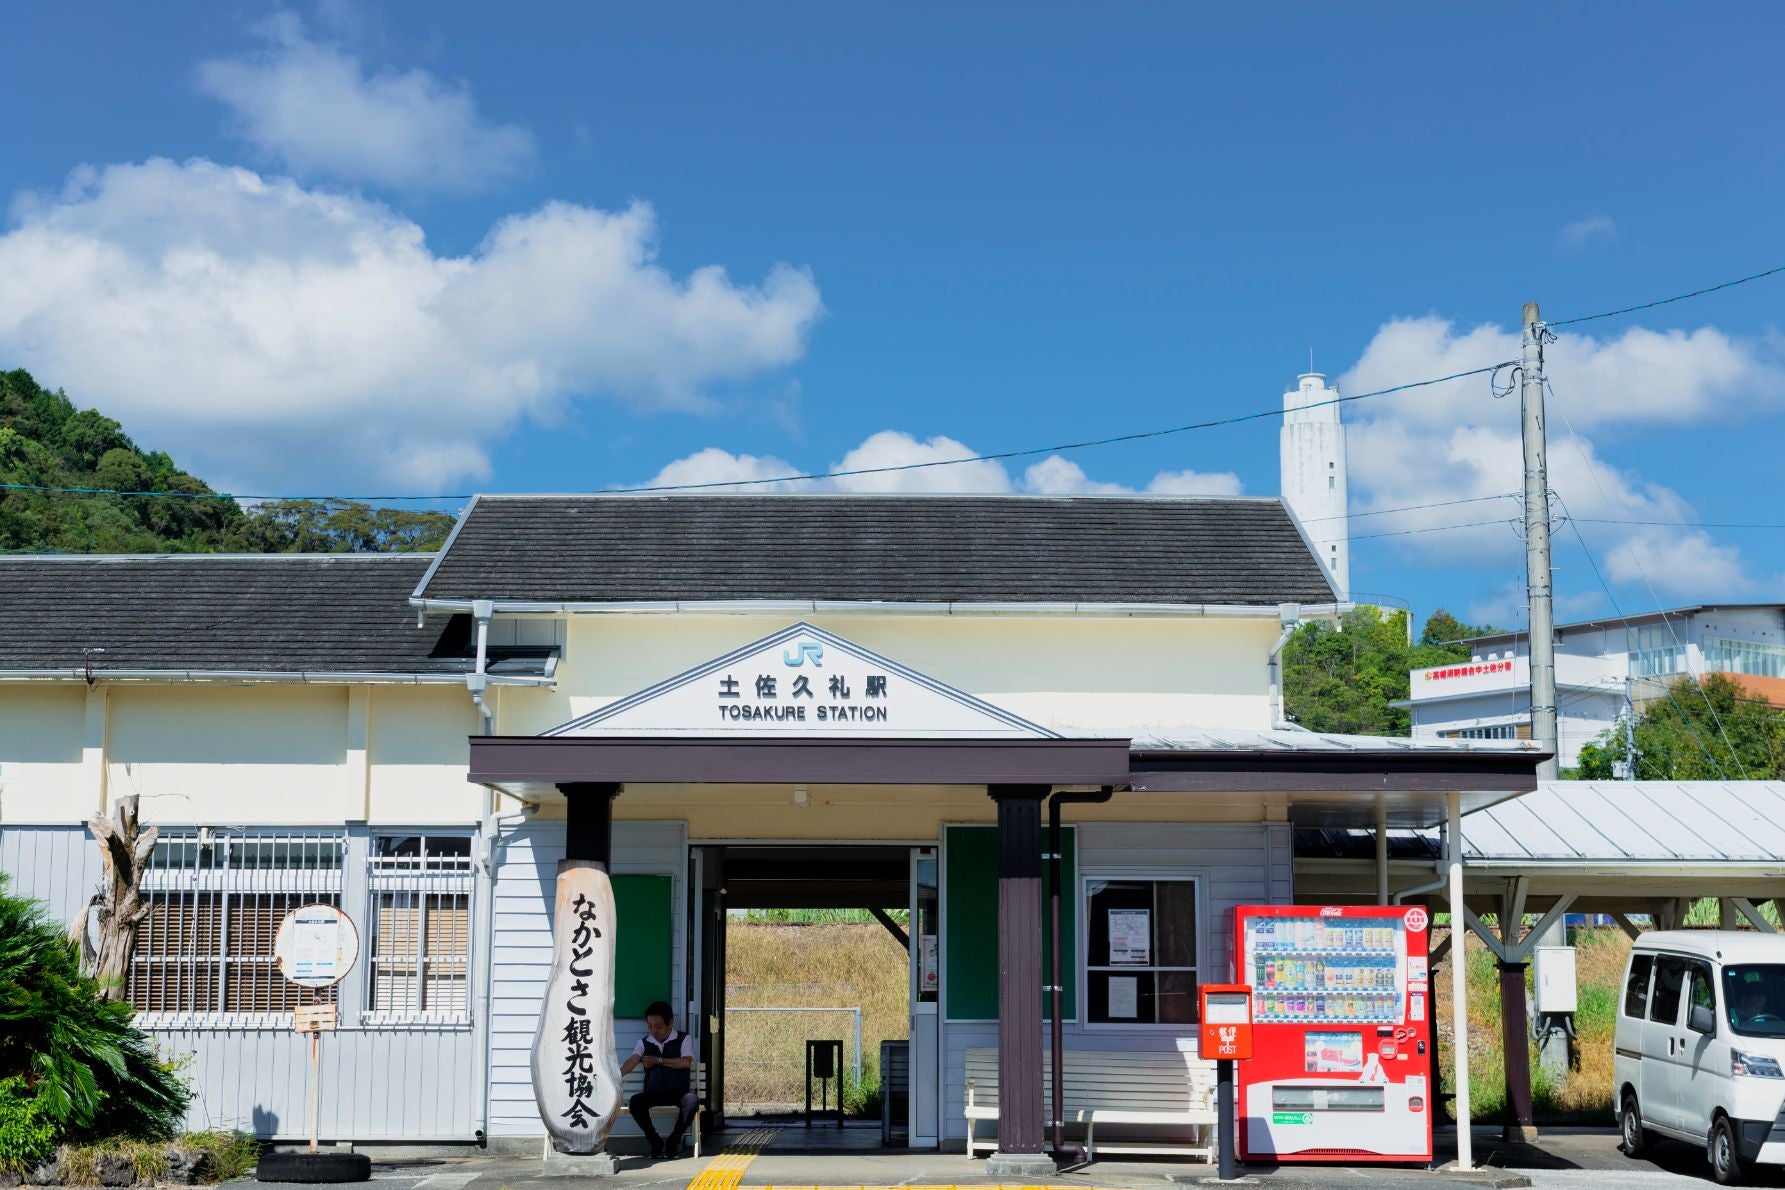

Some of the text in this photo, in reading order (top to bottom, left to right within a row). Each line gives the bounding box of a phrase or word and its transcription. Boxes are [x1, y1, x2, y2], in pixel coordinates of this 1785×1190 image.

[783, 642, 823, 667] JR
[718, 674, 888, 699] 土佐久礼駅
[718, 705, 888, 721] TOSAKURE STATION
[561, 893, 601, 1129] なかとさ観光協会
[1218, 1045, 1237, 1055] POST
